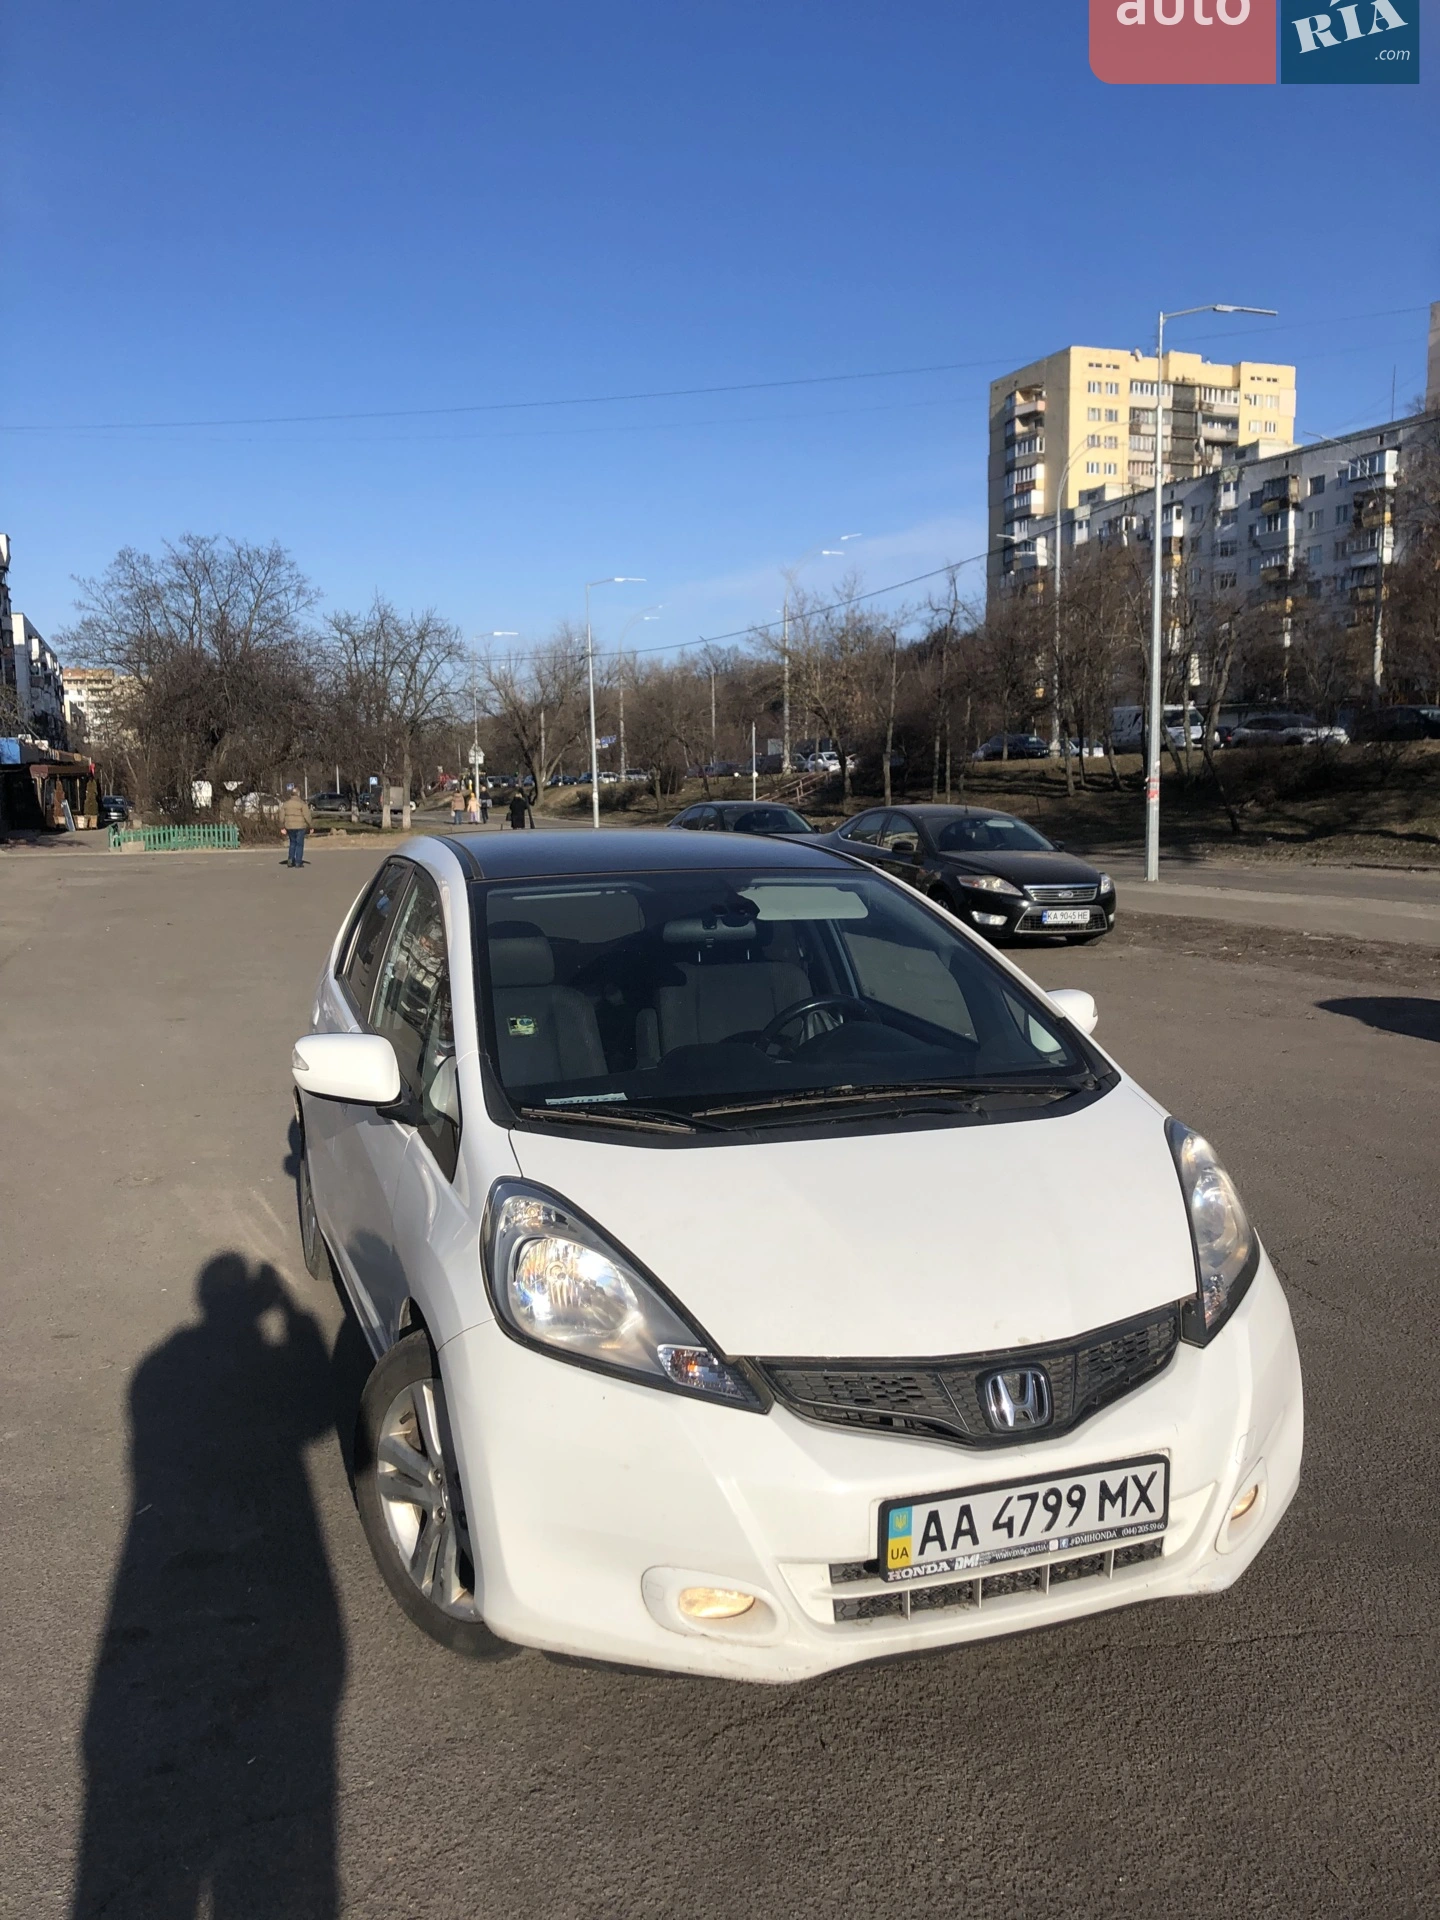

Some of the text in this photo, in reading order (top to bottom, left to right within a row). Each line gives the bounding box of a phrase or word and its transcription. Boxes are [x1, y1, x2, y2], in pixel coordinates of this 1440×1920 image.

[1047, 911, 1088, 920] KA 9045 HE
[918, 1470, 1158, 1556] AA 4799 MX
[891, 1546, 909, 1560] UA
[887, 1561, 951, 1581] HONDA
